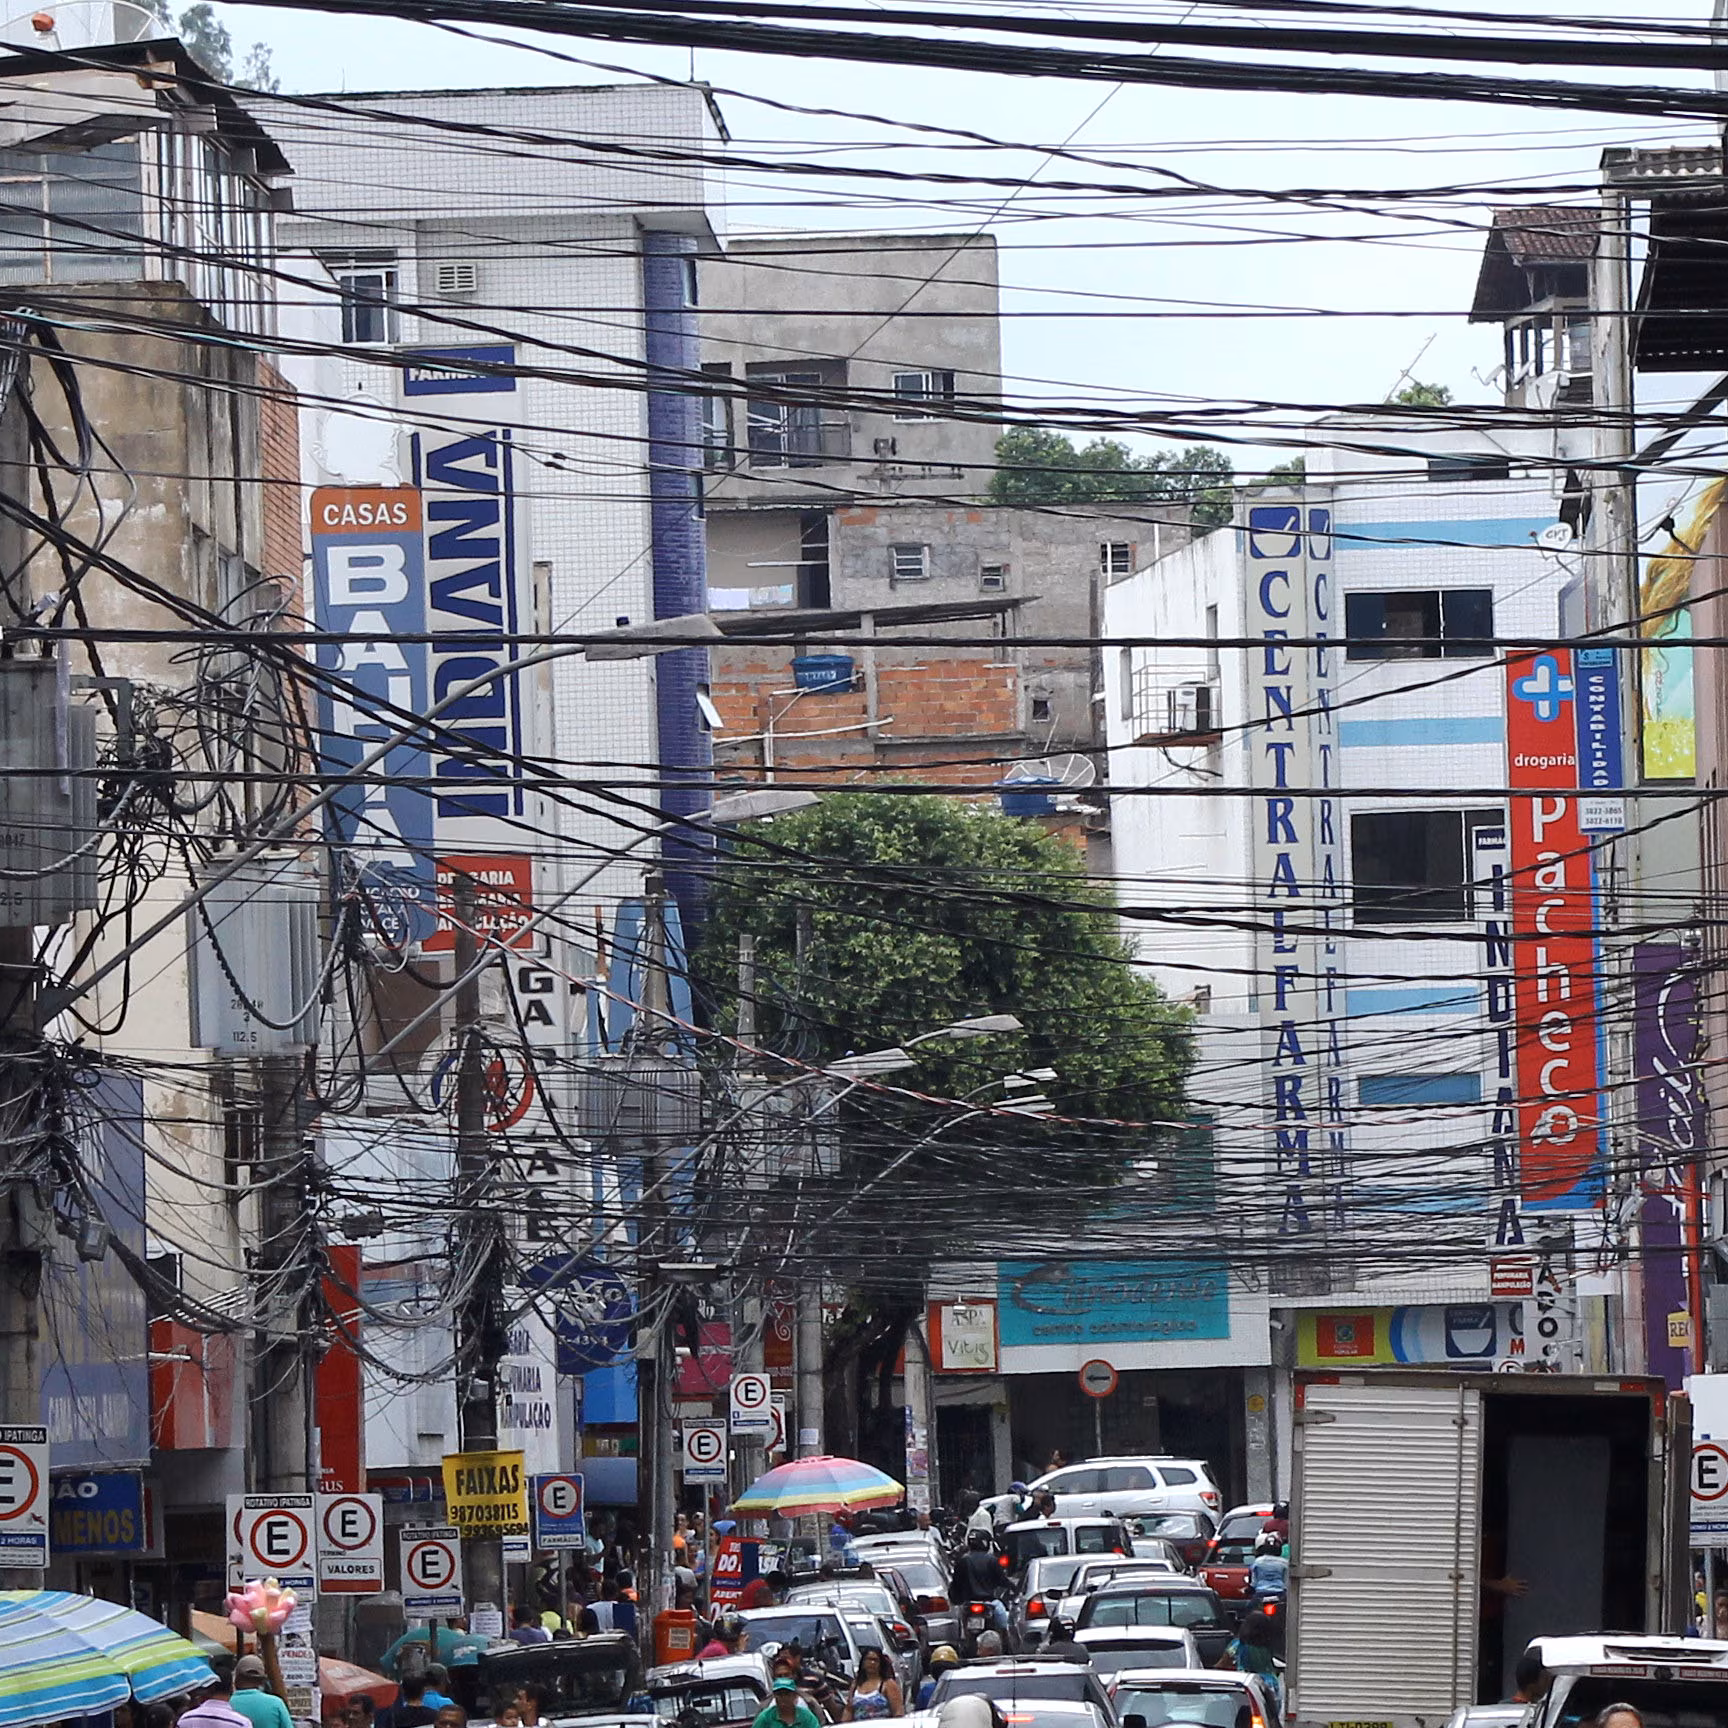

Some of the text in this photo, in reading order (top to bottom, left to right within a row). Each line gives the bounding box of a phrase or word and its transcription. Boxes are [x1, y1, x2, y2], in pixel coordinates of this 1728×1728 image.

[323, 503, 408, 526] CASAS
[427, 430, 523, 817] INDIANA
[326, 544, 417, 869] BAHIA
[1588, 674, 1609, 787] CONTABILIDAD
[1514, 752, 1576, 770] drogaria
[745, 1382, 757, 1401] E
[3, 1428, 45, 1443] IPATINGA
[697, 1435, 710, 1455] E
[455, 1464, 519, 1496] FAIXAS
[1698, 1455, 1719, 1489] E
[49, 1480, 99, 1498] ÃO
[553, 1486, 566, 1509] E
[53, 1508, 135, 1546] MENOS
[341, 1510, 359, 1538] E
[266, 1521, 290, 1556] E
[328, 1565, 375, 1574] VALORES
[422, 1551, 441, 1578] E
